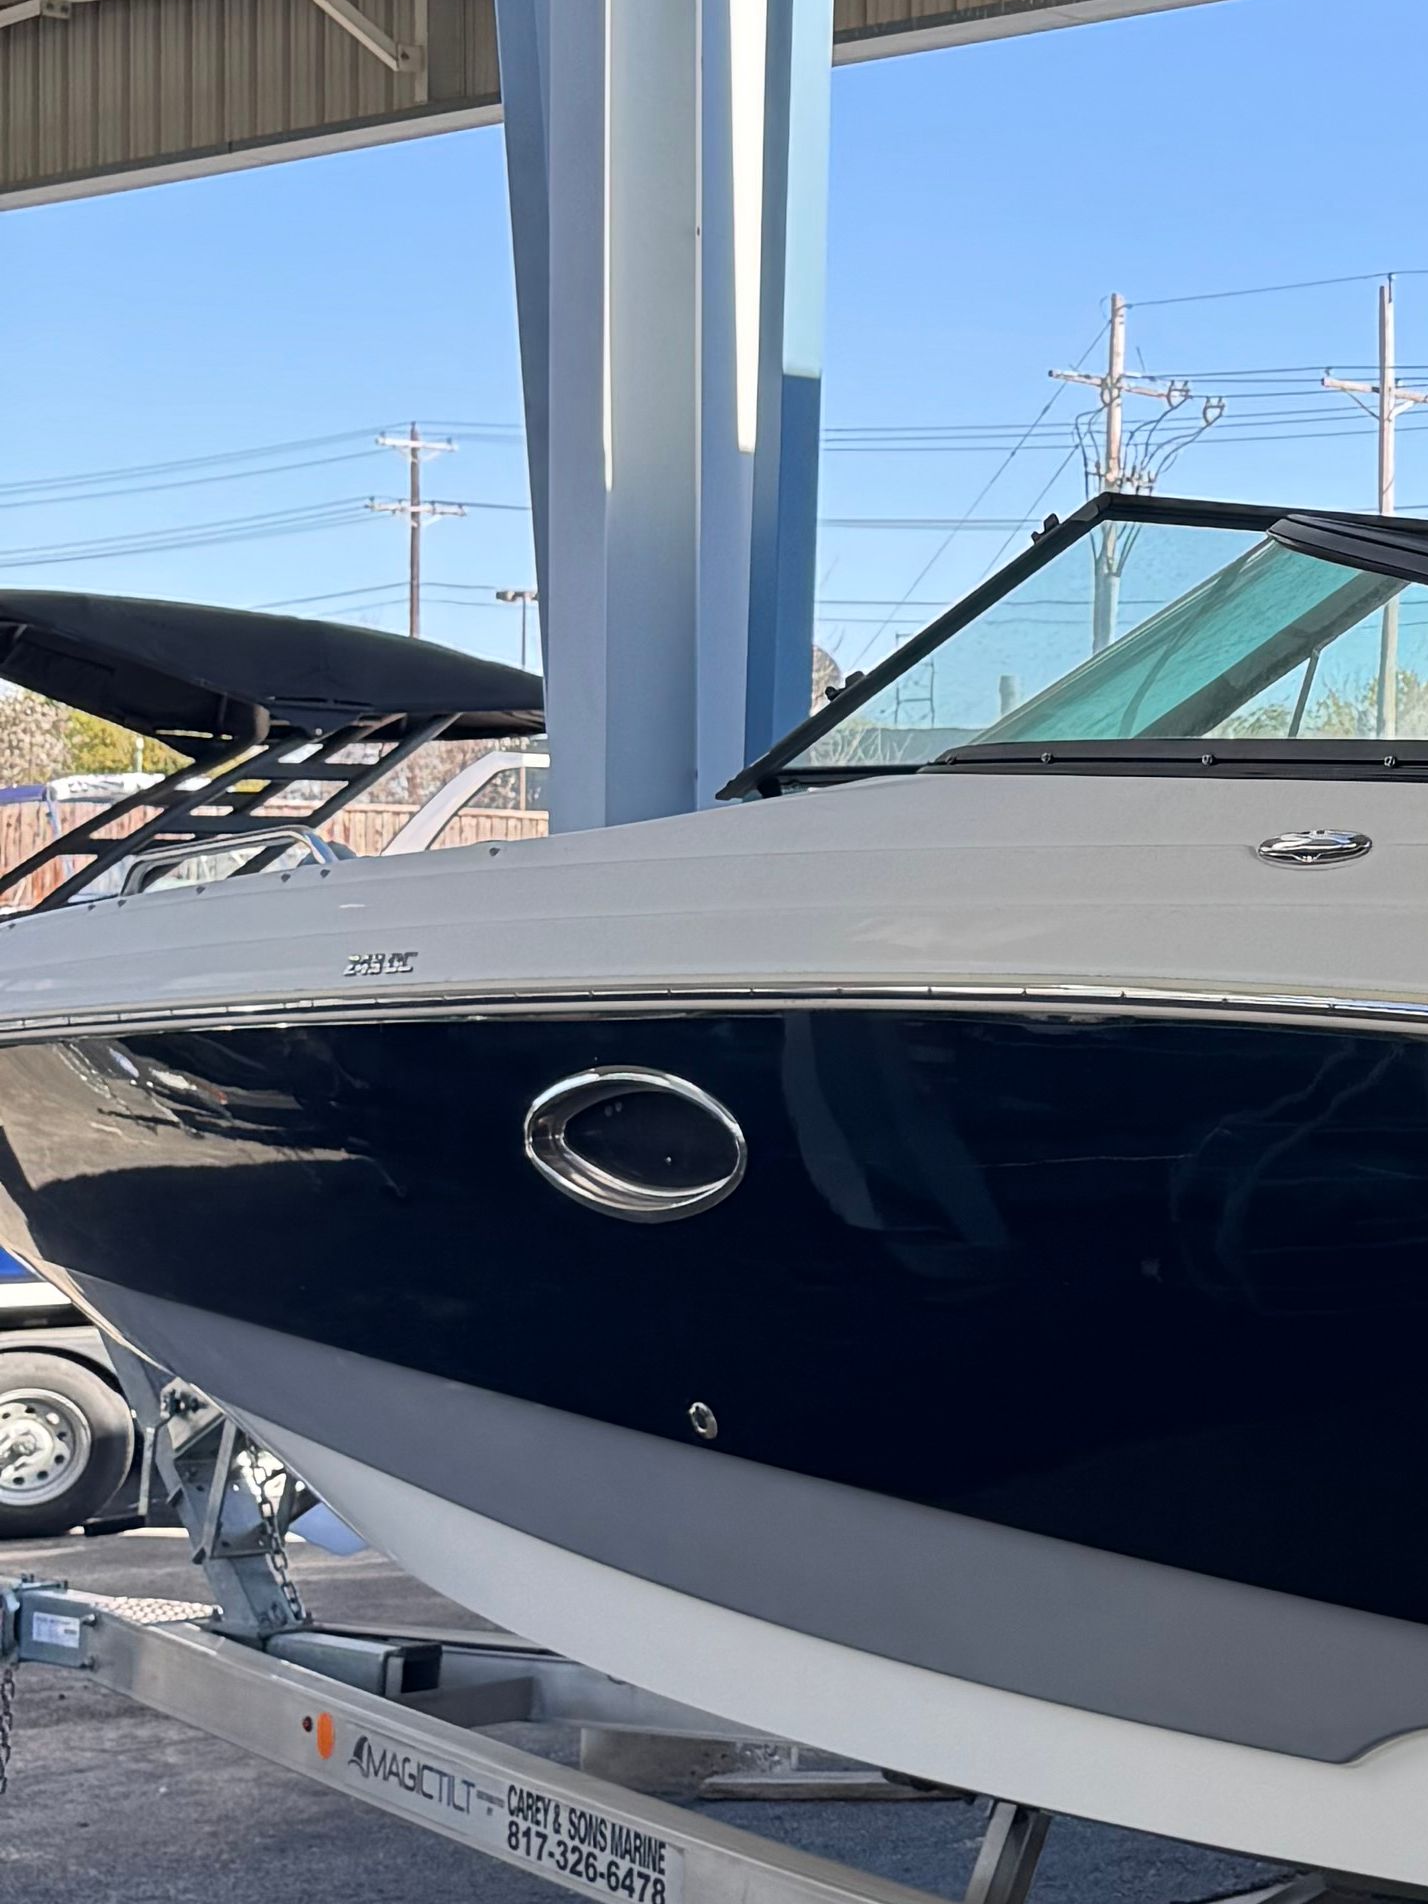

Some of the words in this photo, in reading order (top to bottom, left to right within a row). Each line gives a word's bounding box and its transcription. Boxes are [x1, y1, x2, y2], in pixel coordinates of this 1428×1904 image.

[366, 1742, 476, 1815] MAGICTILT
[507, 1784, 551, 1829] CAREY
[553, 1803, 562, 1835] &
[568, 1807, 607, 1853] SONS
[610, 1823, 667, 1876] MARINE
